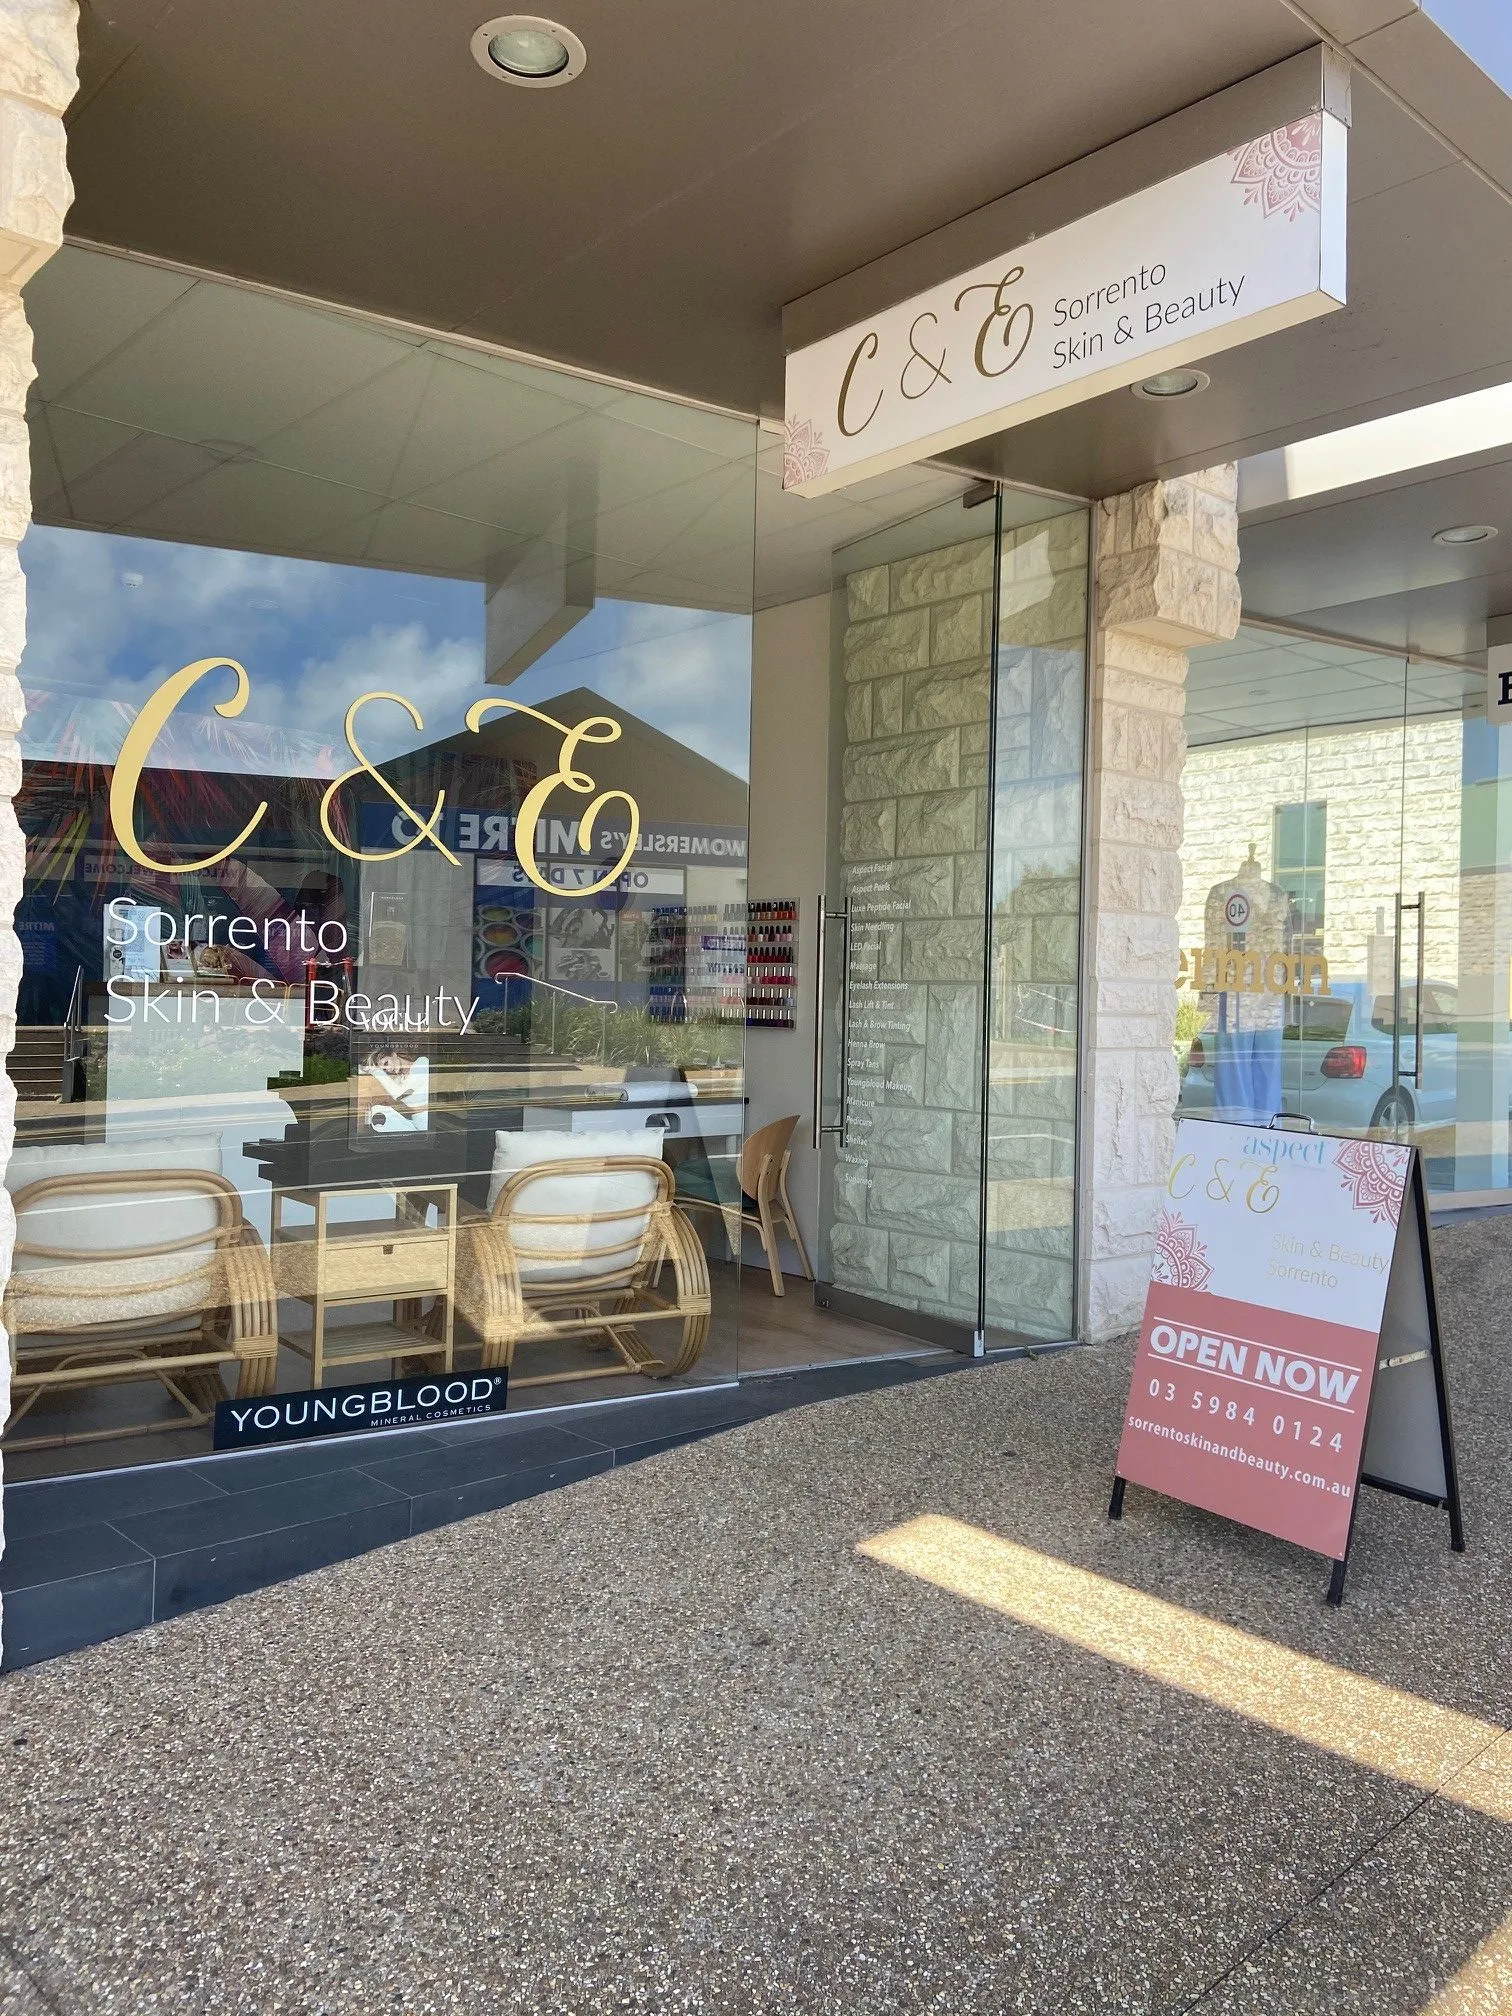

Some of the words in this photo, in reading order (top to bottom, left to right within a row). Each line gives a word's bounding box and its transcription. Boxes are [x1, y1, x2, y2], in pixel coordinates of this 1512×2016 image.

[1053, 264, 1166, 326] Sorrento
[1053, 332, 1103, 369] Skin
[1114, 315, 1134, 345] &
[1145, 275, 1246, 333] Beauty
[837, 332, 884, 437] C
[900, 312, 953, 400] &
[954, 266, 1034, 377] E
[109, 656, 268, 873] C
[320, 691, 462, 866] &
[464, 697, 640, 897] E
[851, 885, 873, 895] Aspect
[851, 904, 866, 913] Luxe
[866, 902, 891, 913] Peptide
[892, 899, 912, 910] Facial
[106, 897, 347, 953] Sorrento
[850, 922, 864, 932] Skin
[865, 921, 895, 932] Needling
[850, 942, 862, 951] LED
[849, 981, 873, 991] Eyelash
[873, 980, 908, 990] Extensions
[104, 975, 220, 1024] Skin
[244, 979, 285, 1025] &
[310, 981, 480, 1036] Beauty
[849, 1000, 863, 1009] Lash
[864, 1000, 874, 1009] Lift
[875, 1001, 880, 1009] &
[849, 1019, 863, 1028] Lash
[869, 1020, 886, 1029] Brow
[868, 1040, 886, 1049] Brow
[847, 1057, 864, 1069] Spray
[885, 1080, 912, 1092] Makeup
[1242, 1136, 1327, 1164] aspect
[1168, 1153, 1195, 1199] C
[1205, 1158, 1234, 1202] &
[1240, 1160, 1279, 1213] E
[1273, 1233, 1304, 1255] Skin
[1309, 1240, 1323, 1258] &
[1329, 1244, 1390, 1275] Beauty
[1267, 1257, 1338, 1289] Sorrento
[1150, 1325, 1248, 1375] OPEN
[1255, 1350, 1360, 1404] NOW
[370, 1414, 422, 1427] MINERAL
[426, 1404, 491, 1419] COSMETICS
[1149, 1378, 1176, 1401] 03
[1191, 1391, 1255, 1425] 5984
[1273, 1415, 1342, 1453] 0124
[1128, 1415, 1351, 1498] sorrentoskinandbeauty.com.au
